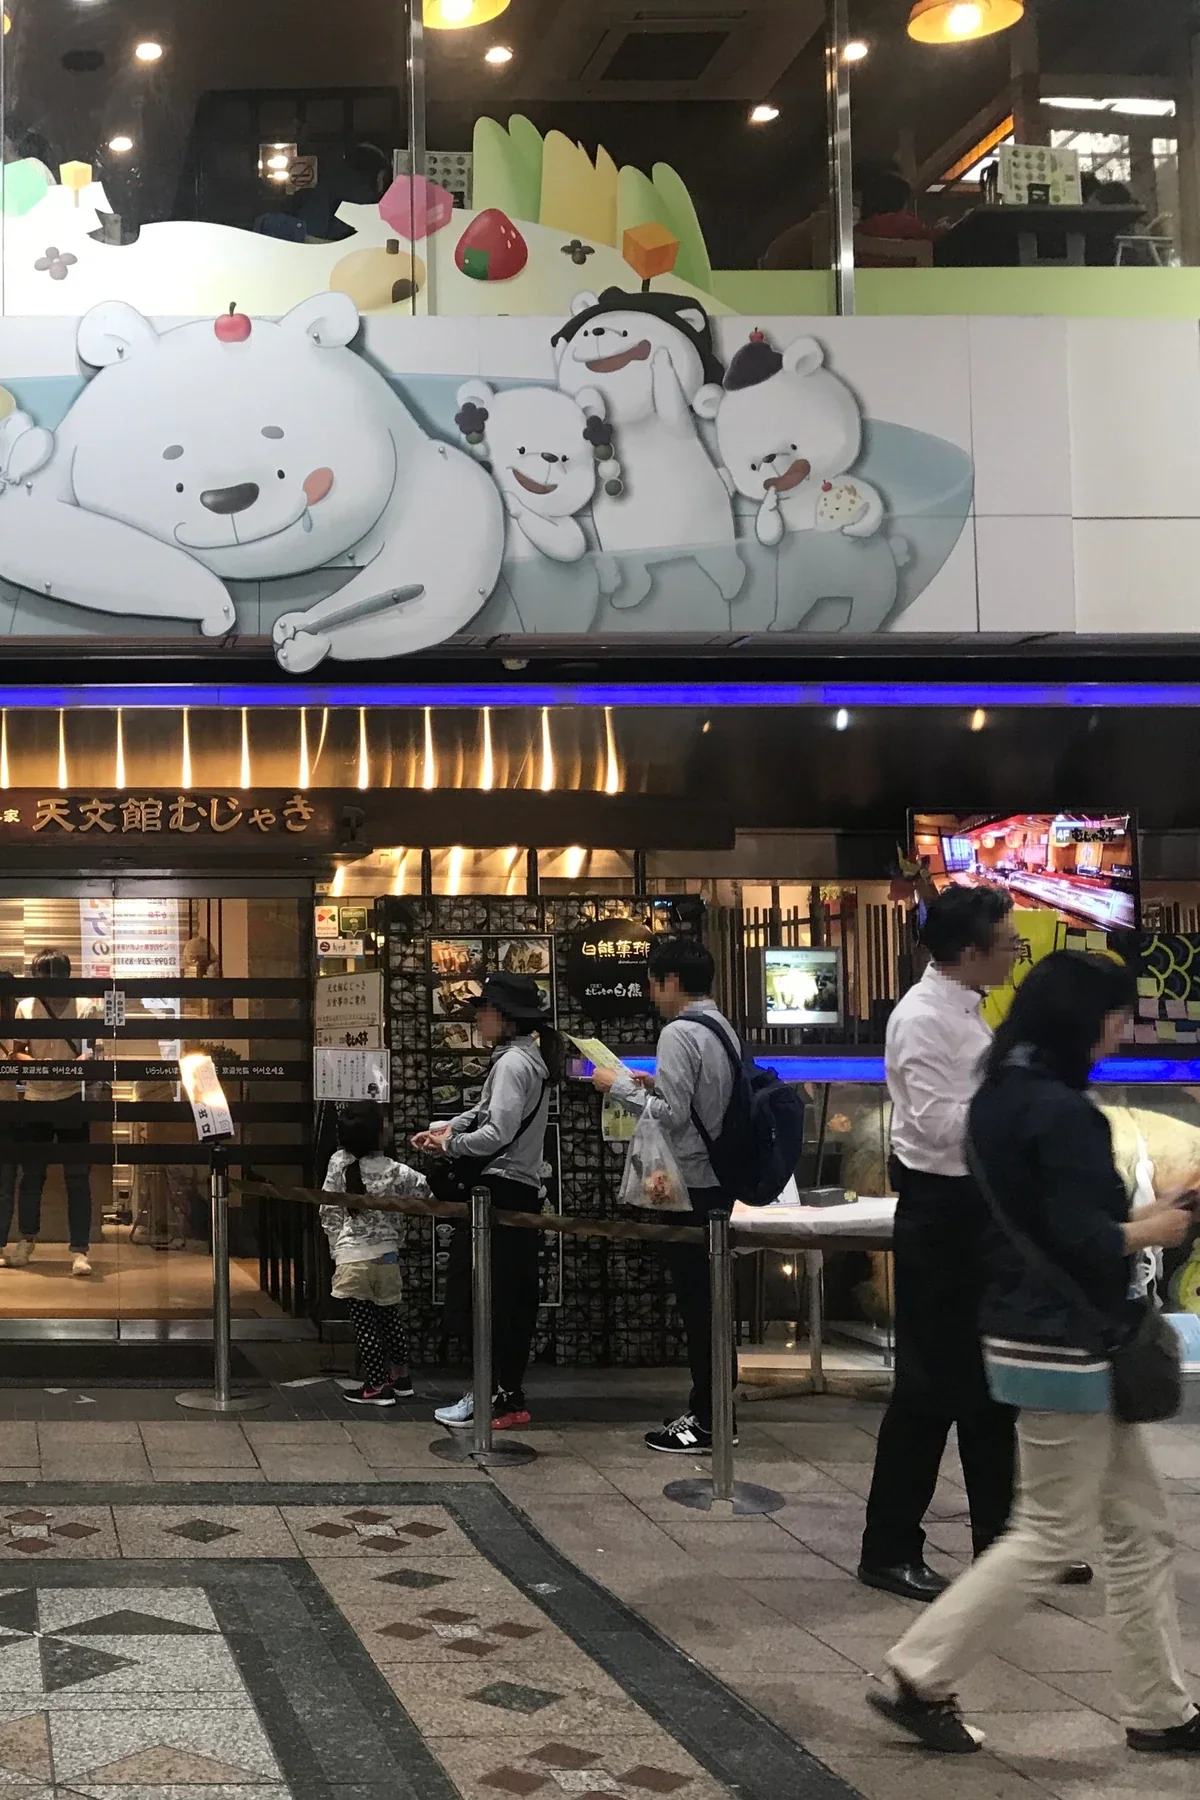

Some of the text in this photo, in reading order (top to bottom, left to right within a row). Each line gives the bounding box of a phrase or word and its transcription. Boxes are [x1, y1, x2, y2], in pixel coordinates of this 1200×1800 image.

[31, 794, 316, 834] 天文館むじゃき
[52, 1066, 84, 1075] 어서오세요
[252, 1067, 284, 1075] 어서오세요
